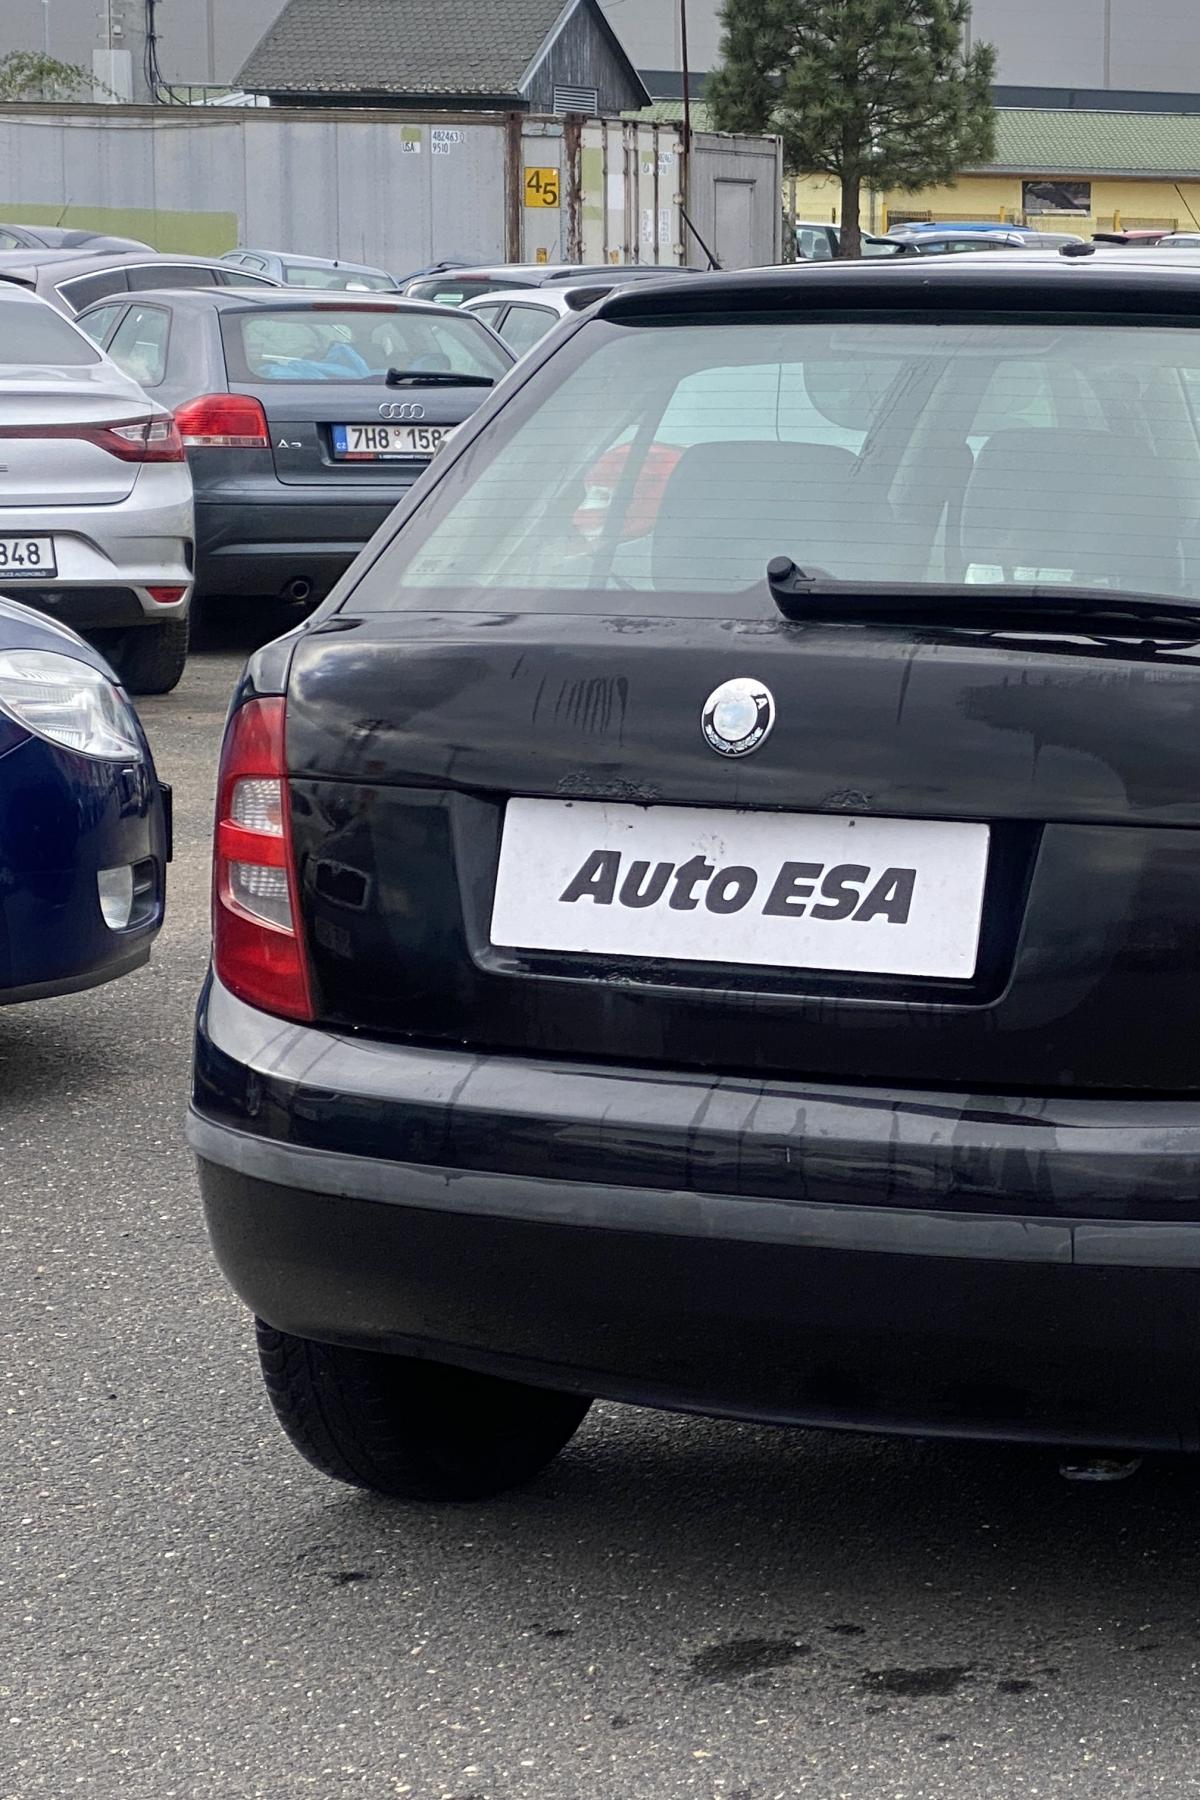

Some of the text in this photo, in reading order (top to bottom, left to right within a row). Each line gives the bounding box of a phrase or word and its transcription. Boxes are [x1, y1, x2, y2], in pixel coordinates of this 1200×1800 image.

[402, 142, 415, 152] USA
[432, 143, 449, 153] 9510
[350, 428, 452, 450] 7H8 158
[559, 849, 917, 925] Auto ESA
